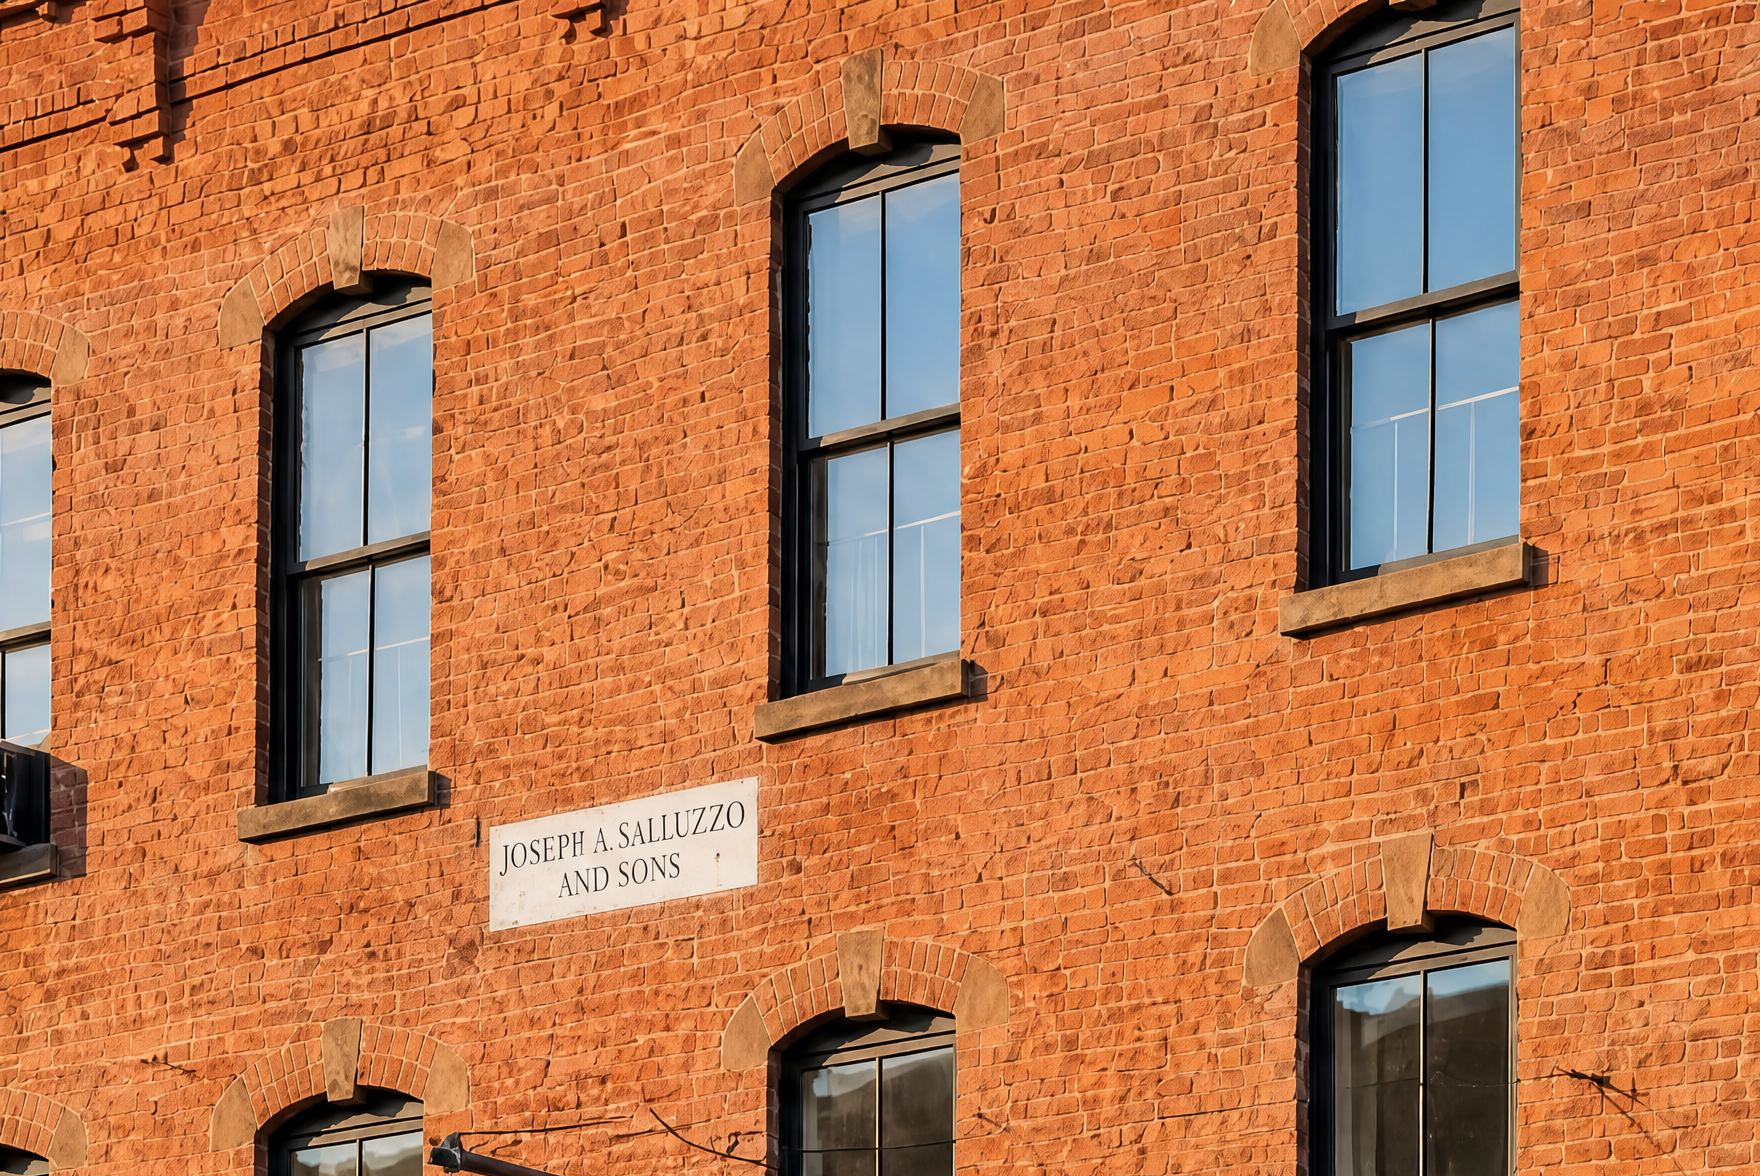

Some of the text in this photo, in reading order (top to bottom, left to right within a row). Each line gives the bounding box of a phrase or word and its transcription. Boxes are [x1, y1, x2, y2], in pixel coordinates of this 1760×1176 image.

[499, 800, 745, 877] JOSEPH A. SALLUZZO
[558, 852, 681, 899] AND SONS
